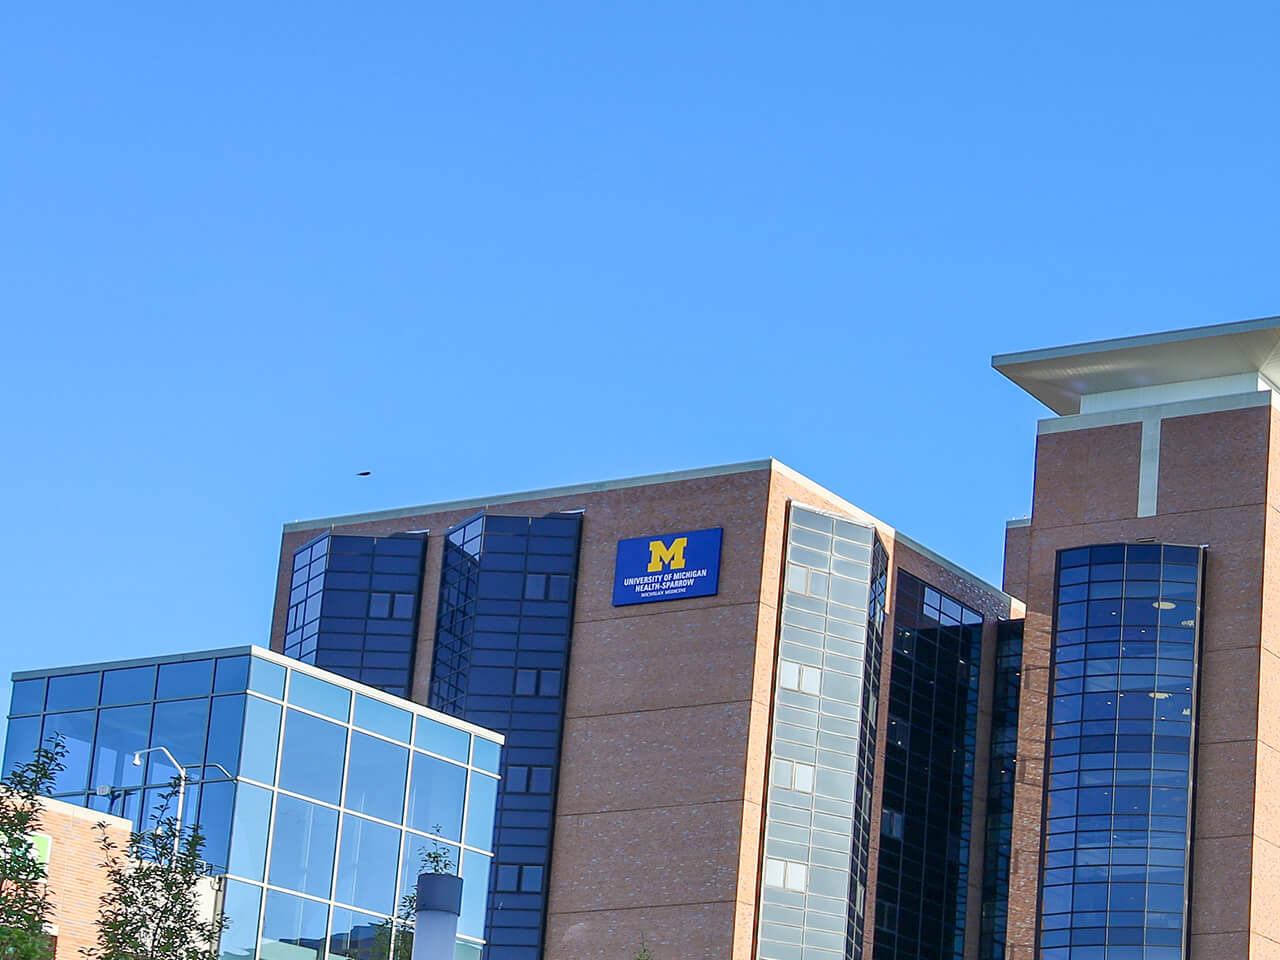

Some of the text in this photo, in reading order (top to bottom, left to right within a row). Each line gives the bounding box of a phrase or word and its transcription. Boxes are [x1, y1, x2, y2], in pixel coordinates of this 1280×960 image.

[647, 537, 688, 573] M
[624, 568, 707, 586] UNIVERSITY OF MICHIGAN
[635, 578, 695, 593] HEALTH-SPARROW
